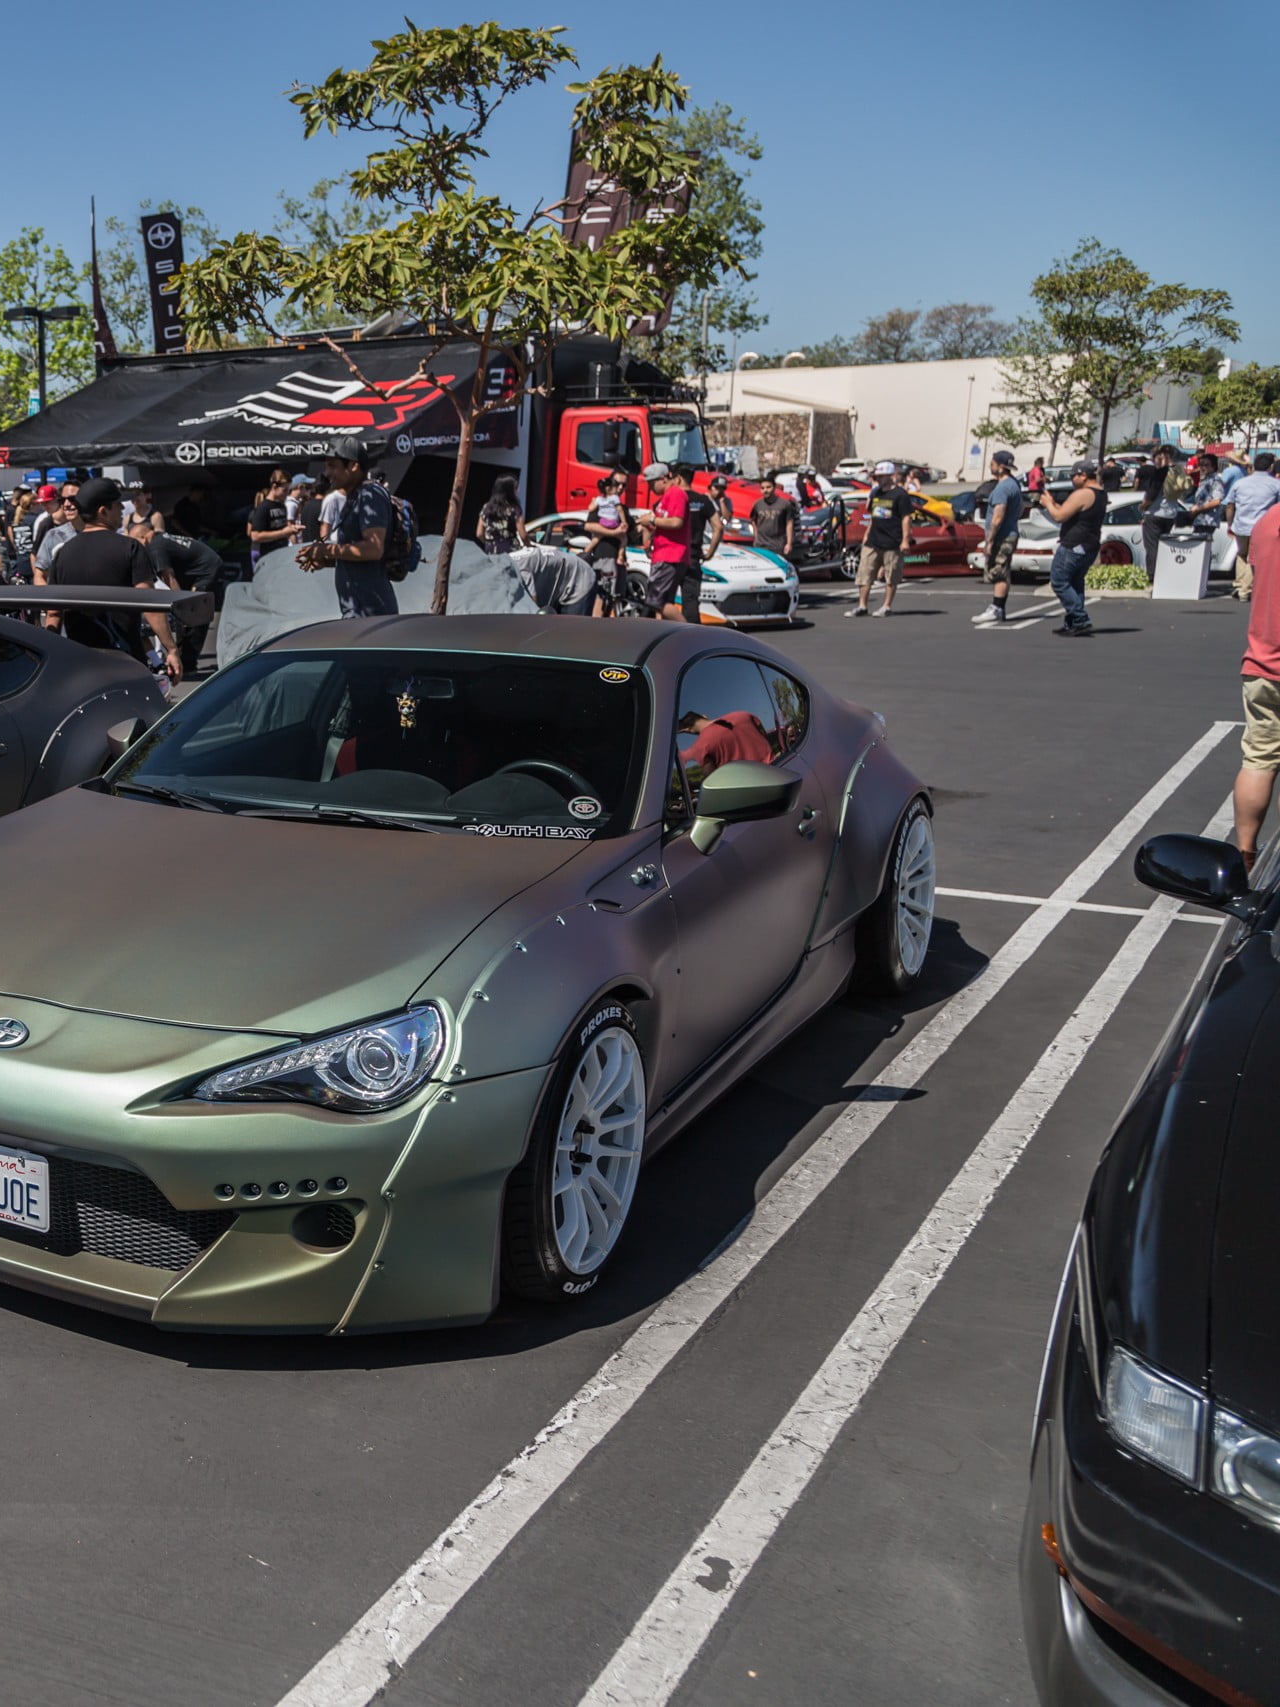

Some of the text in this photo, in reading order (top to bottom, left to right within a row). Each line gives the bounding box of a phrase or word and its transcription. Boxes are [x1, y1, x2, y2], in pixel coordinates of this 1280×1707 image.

[602, 670, 628, 680] VIP
[545, 826, 596, 840] BAY
[580, 1006, 622, 1046] PROXES
[562, 1273, 599, 1294] TOYO
